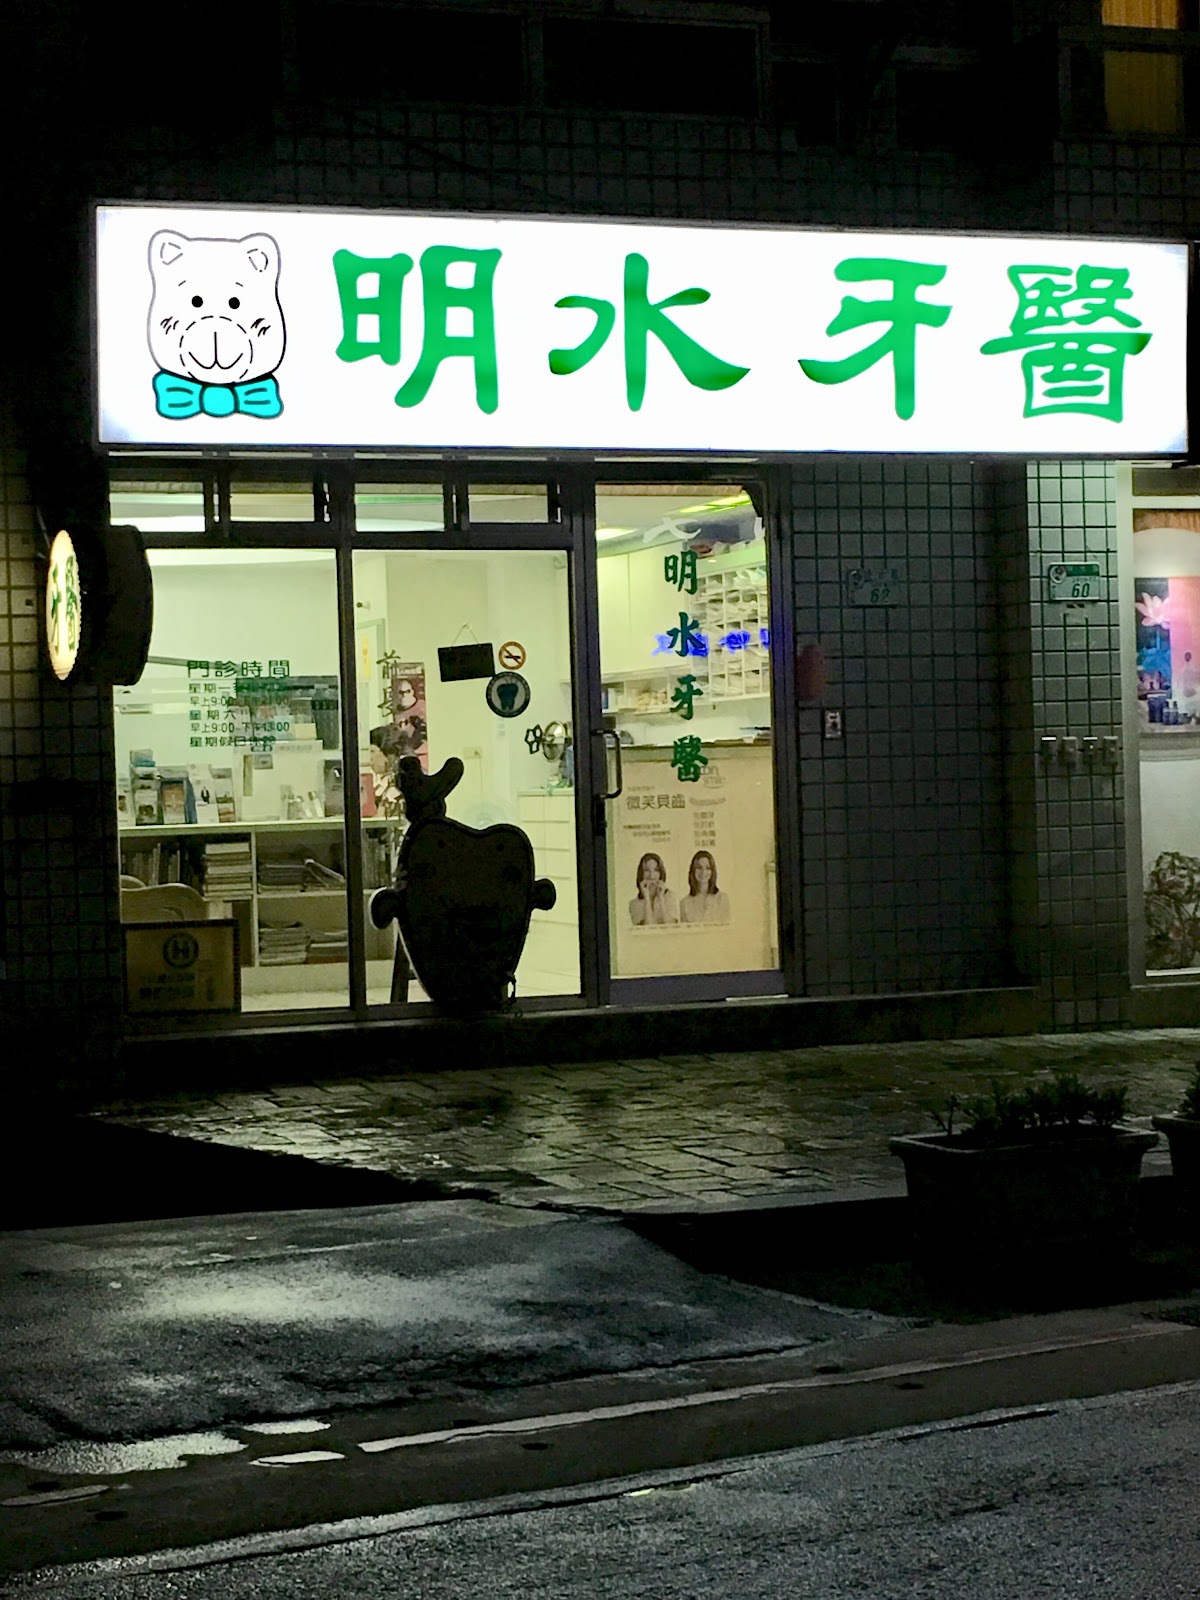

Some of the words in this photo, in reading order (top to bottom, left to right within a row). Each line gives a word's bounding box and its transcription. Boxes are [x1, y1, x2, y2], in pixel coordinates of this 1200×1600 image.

[333, 245, 1152, 423] 明水牙醫
[1071, 582, 1091, 598] 60
[187, 660, 290, 678] 門診時間
[664, 549, 709, 784] 明水牙醫
[189, 710, 237, 721] 星期六
[626, 794, 686, 810] 微笑貝齒
